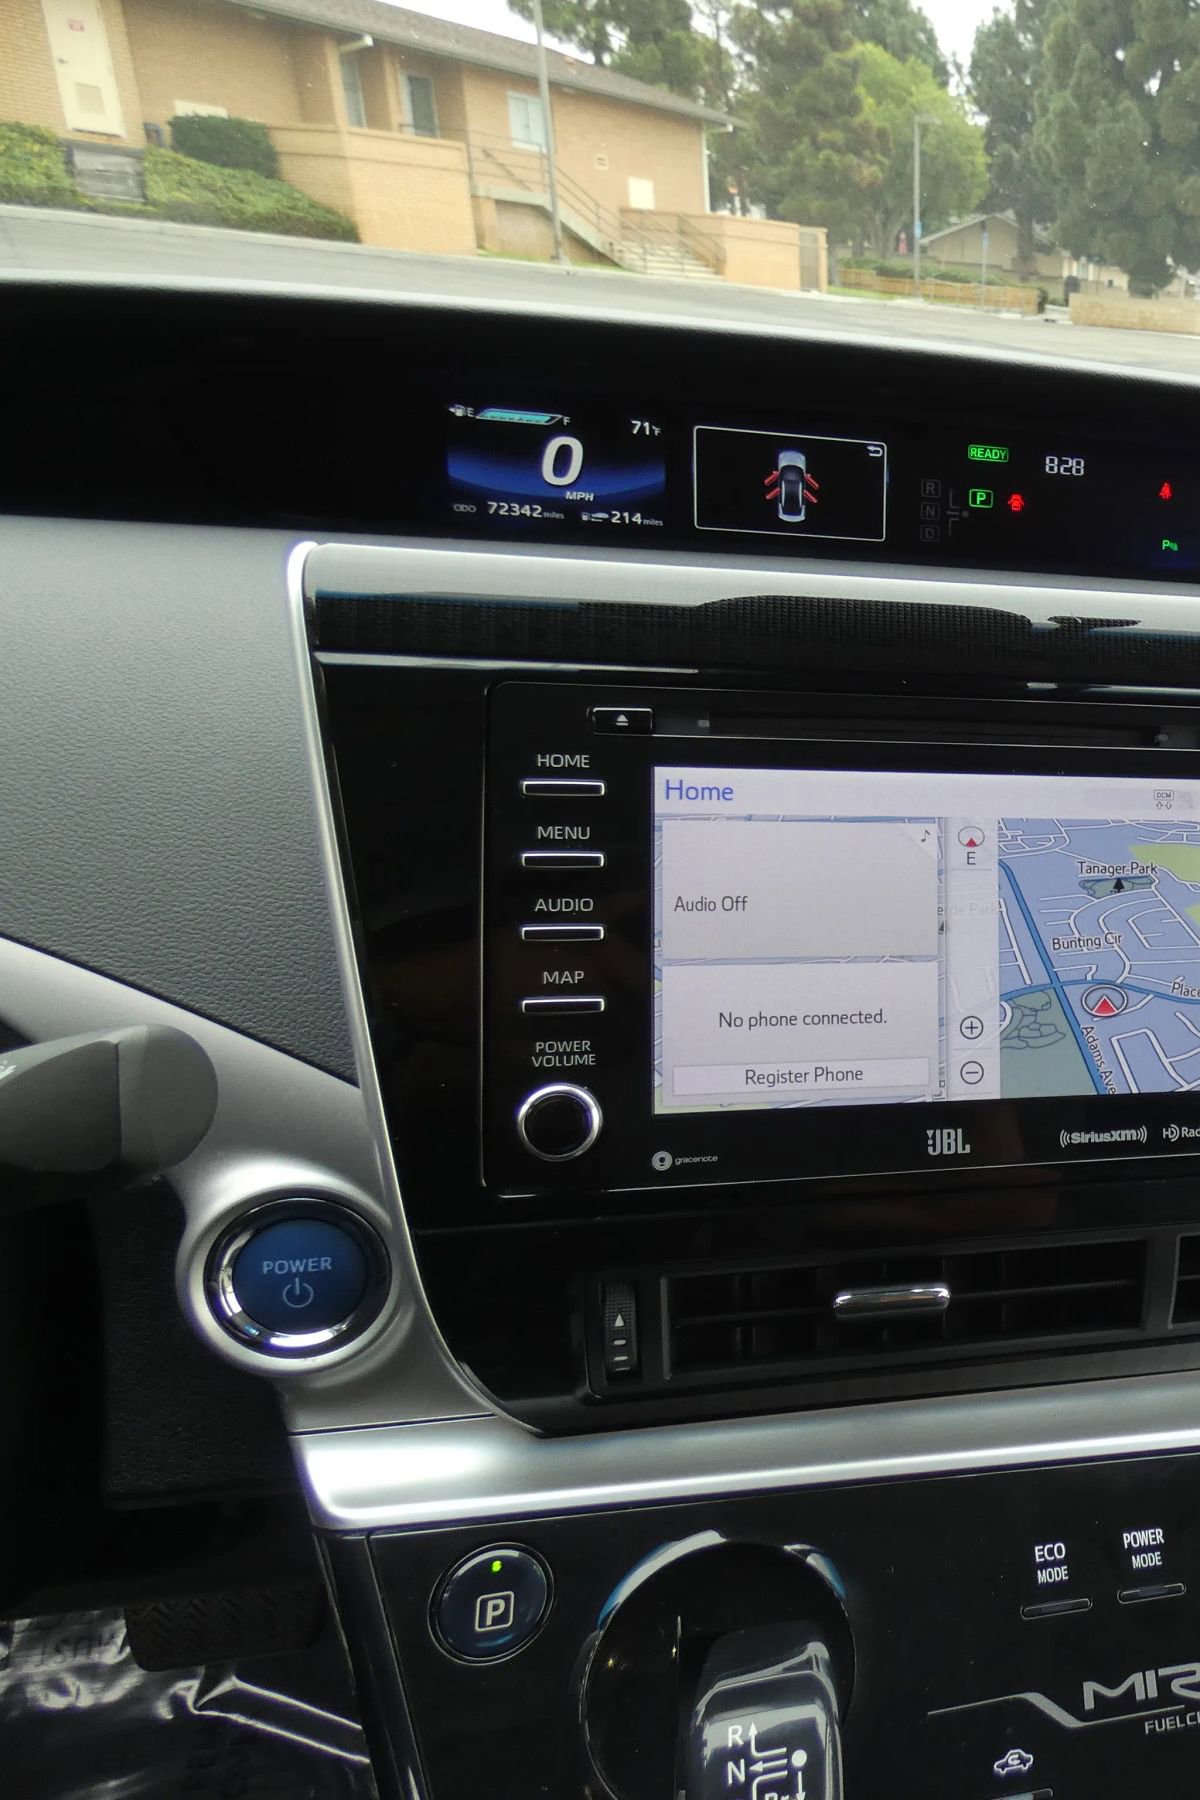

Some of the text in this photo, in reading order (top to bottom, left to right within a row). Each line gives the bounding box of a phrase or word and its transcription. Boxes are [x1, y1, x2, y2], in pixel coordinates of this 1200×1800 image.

[563, 417, 571, 426] F
[541, 435, 584, 486] 0
[969, 447, 1008, 461] READY
[565, 491, 594, 501] MPH
[975, 492, 987, 506] P
[487, 501, 565, 520] 72342 miles
[611, 511, 664, 527] 214 miles
[537, 754, 590, 768] HOME
[665, 779, 734, 801] Home
[537, 826, 591, 840] MENU
[966, 852, 976, 866] E
[1077, 862, 1158, 878] Tanager Park
[534, 898, 594, 912] AUDIO
[673, 895, 749, 912] Audio Off
[1052, 932, 1123, 951] Bunting Cir
[543, 970, 585, 985] MAP
[718, 1008, 888, 1031] No phone connected.
[535, 1040, 591, 1053] POWER
[531, 1054, 597, 1068] VOLUME
[1081, 1025, 1117, 1095] Adams Ave
[744, 1066, 864, 1087] Register Phone
[926, 1128, 971, 1156] JBL
[674, 1155, 719, 1166] gracenote
[262, 1256, 333, 1275] POWER
[1122, 1528, 1165, 1549] POWER
[1034, 1543, 1066, 1563] ECO
[1131, 1551, 1163, 1570] MODE
[1037, 1566, 1069, 1585] MODE
[485, 1598, 507, 1627] P
[1144, 1712, 1186, 1735] FUEL
[727, 1724, 745, 1748] R
[727, 1758, 746, 1785] N
